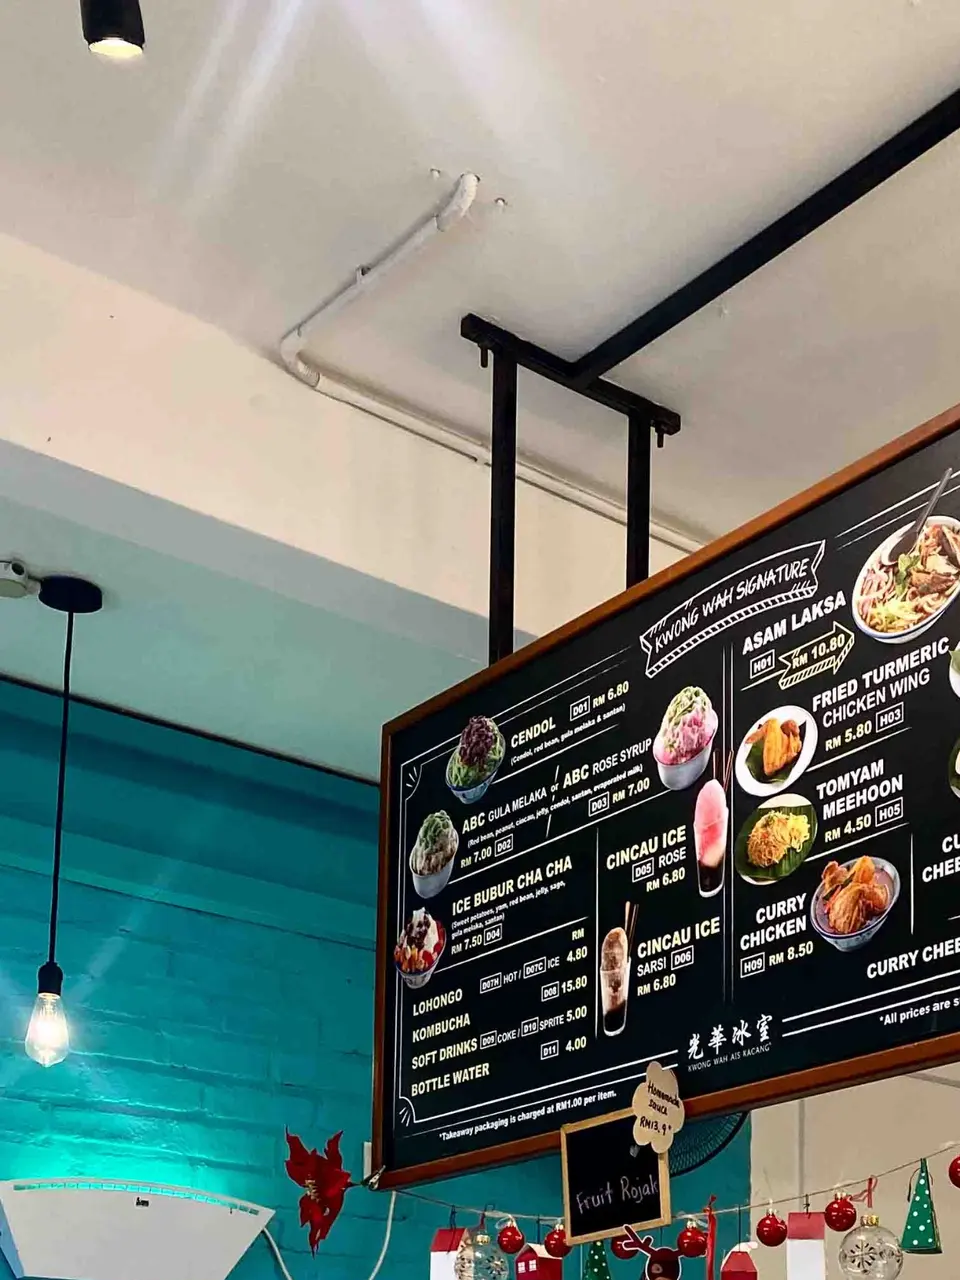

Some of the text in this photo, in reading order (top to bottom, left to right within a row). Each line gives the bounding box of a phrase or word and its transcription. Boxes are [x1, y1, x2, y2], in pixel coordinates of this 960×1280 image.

[655, 558, 810, 653] KWONG WAH SIGNATURE
[743, 591, 847, 655] ASAM LAKSA
[811, 634, 845, 660] 10.80
[812, 637, 949, 712] FRIED TURMERIC
[511, 681, 629, 748] CENDOL 6.80
[822, 668, 930, 728] CHICKEN WING
[844, 720, 872, 743] 5.80
[563, 738, 652, 788] ABC ROSE SYRUP
[816, 759, 883, 799] TOMYAM
[628, 778, 650, 796] 7.00
[823, 774, 903, 820] MEEHOON
[462, 787, 547, 834] ABC GULA MELAKA
[844, 814, 871, 835] 4.50
[473, 846, 491, 862] 7.00
[606, 825, 686, 870] CINCAU ICE
[659, 847, 686, 868] ROSE
[452, 856, 572, 916] ICE BUBUR CHA CHA
[663, 867, 685, 885] 6.80
[756, 893, 807, 924] CURRY
[464, 935, 482, 950] 7.50
[637, 917, 720, 958] CINCAU ICE
[740, 915, 807, 951] CHICKEN
[787, 941, 813, 960] 8.50
[413, 946, 587, 1016] LOHONGO HOT ICE 4.80
[637, 957, 666, 977] SARSI
[653, 974, 676, 991] 6.80
[412, 976, 587, 1043] KOMBUCHA 15.80
[900, 1004, 930, 1023] prices
[933, 1000, 950, 1012] are
[412, 1006, 587, 1069] SOFT DRINKS COKE SPRITE 5.00
[411, 1036, 586, 1097] BOTTLE WATER 4.00
[687, 1044, 770, 1072] KWONG WAH AIS KACANG
[475, 1118, 508, 1134] packaging
[518, 1109, 545, 1122] charged
[546, 1105, 554, 1113] at
[555, 1097, 582, 1111] RM1.00
[584, 1095, 596, 1106] per
[598, 1089, 616, 1101] item.
[576, 1174, 658, 1214] Fruit Rojak
